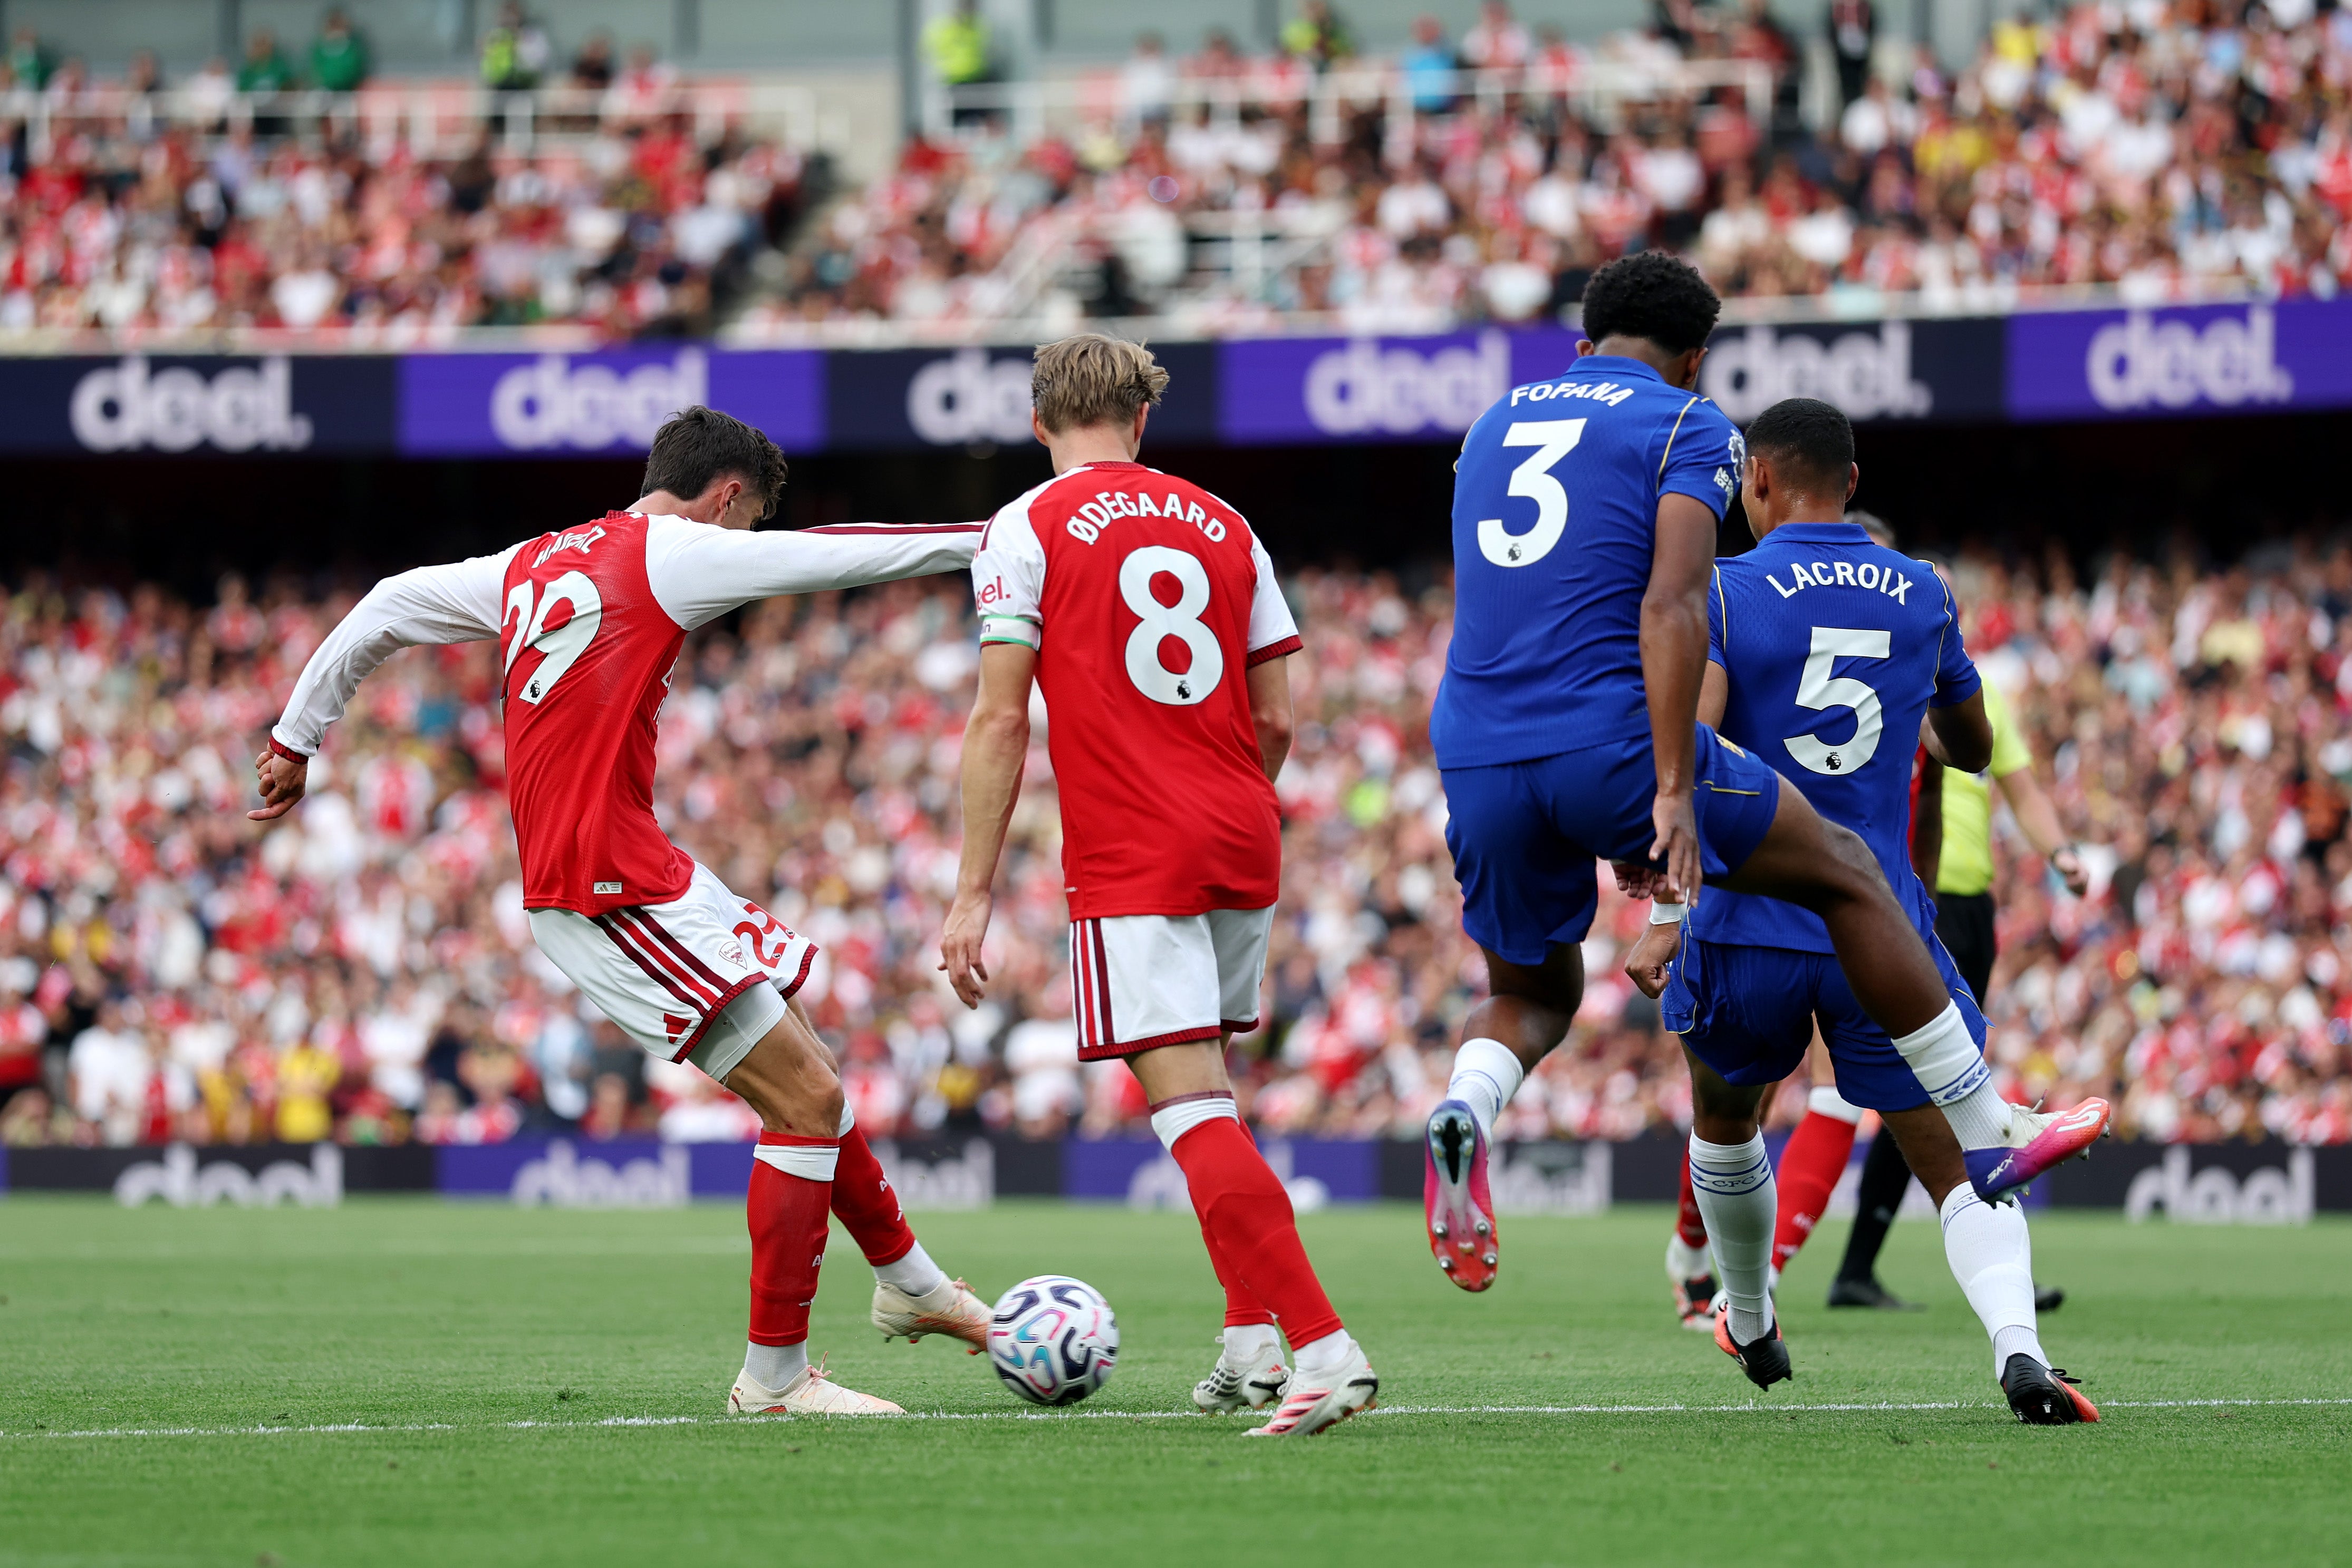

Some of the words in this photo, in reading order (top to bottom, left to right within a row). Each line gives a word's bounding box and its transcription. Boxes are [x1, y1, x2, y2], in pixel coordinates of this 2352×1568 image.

[1511, 382, 1634, 406] FOFANA
[1477, 418, 1587, 568] 3
[1066, 491, 1227, 545] ØDEGAARD
[977, 576, 1011, 611] eel.
[1766, 562, 1913, 605] LACROIX
[502, 570, 602, 705] 29
[1119, 545, 1224, 705] 8
[1782, 626, 1891, 776] 5
[1712, 1176, 1757, 1187] CFC
[1987, 1154, 2013, 1184] SKX
